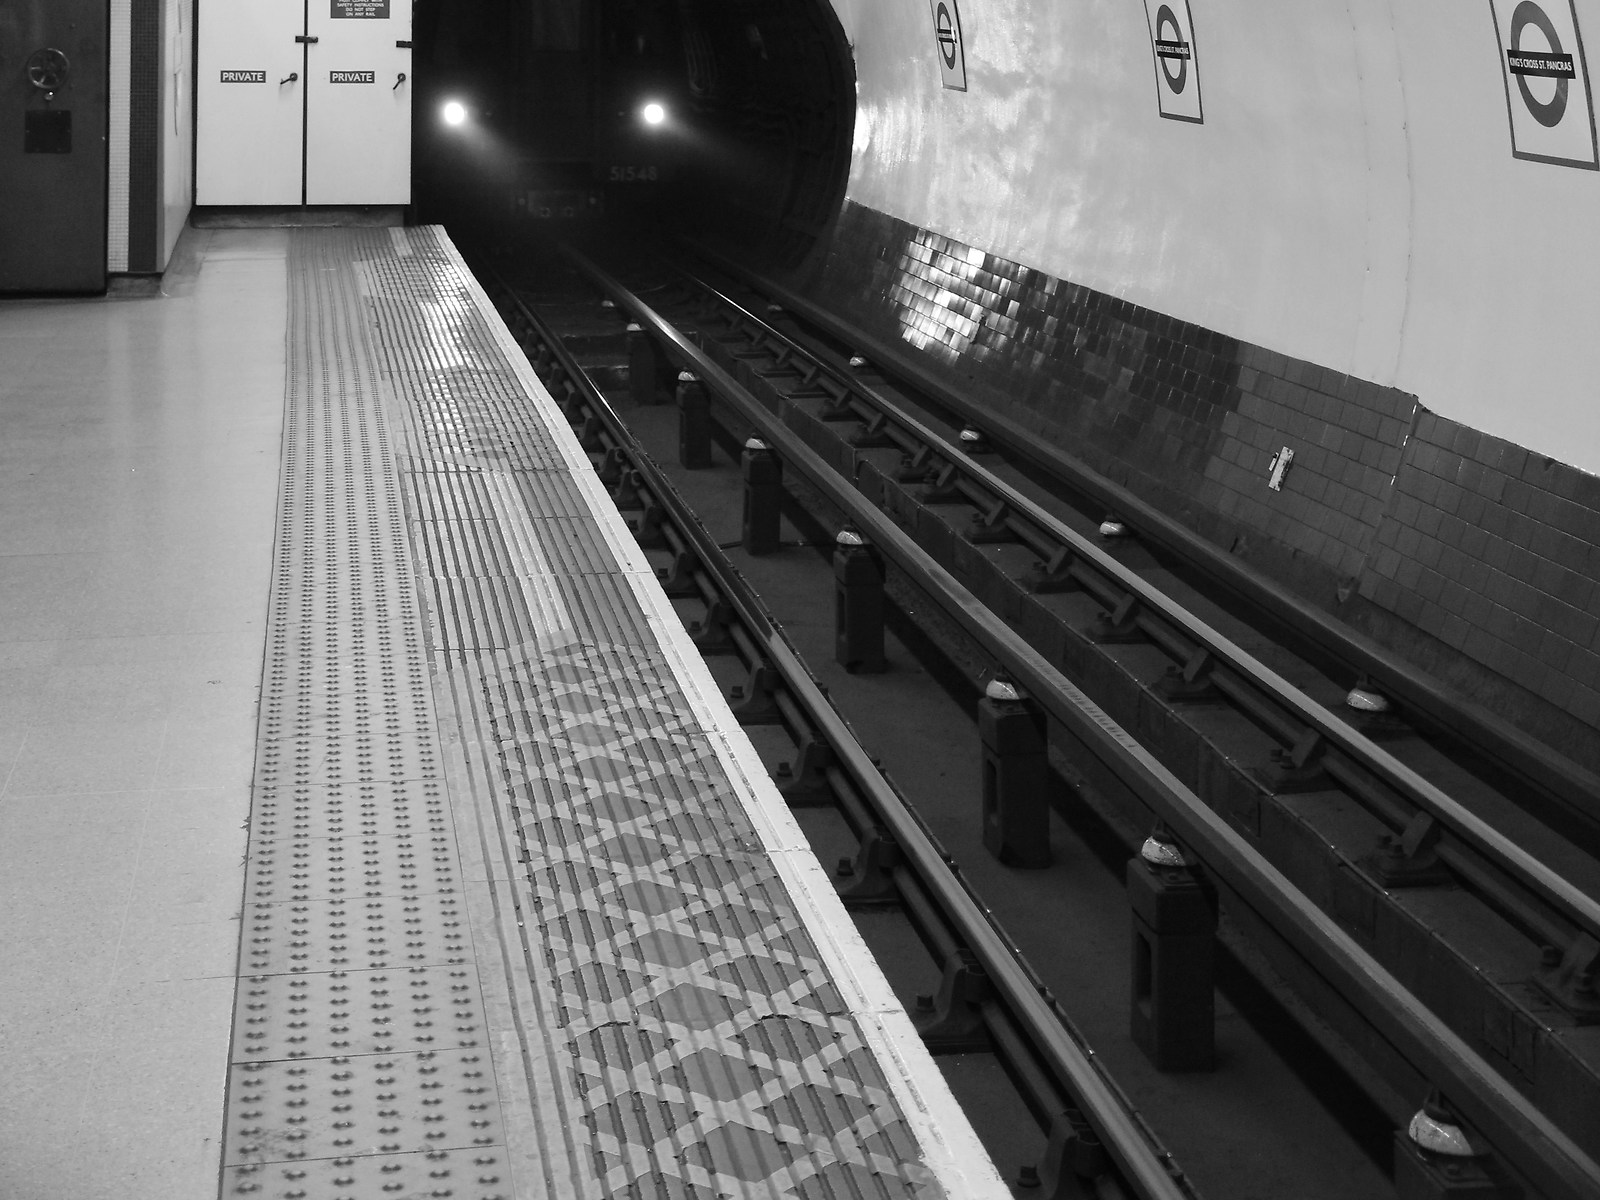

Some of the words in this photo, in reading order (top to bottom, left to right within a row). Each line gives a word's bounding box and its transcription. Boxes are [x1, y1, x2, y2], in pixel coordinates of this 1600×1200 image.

[1509, 57, 1523, 68] KING'S
[1523, 59, 1538, 69] CROSS
[1538, 60, 1547, 70] ST.
[1546, 61, 1573, 71] PANCRAS
[222, 72, 264, 81] PRIVATE
[332, 72, 373, 81] PRIVATE
